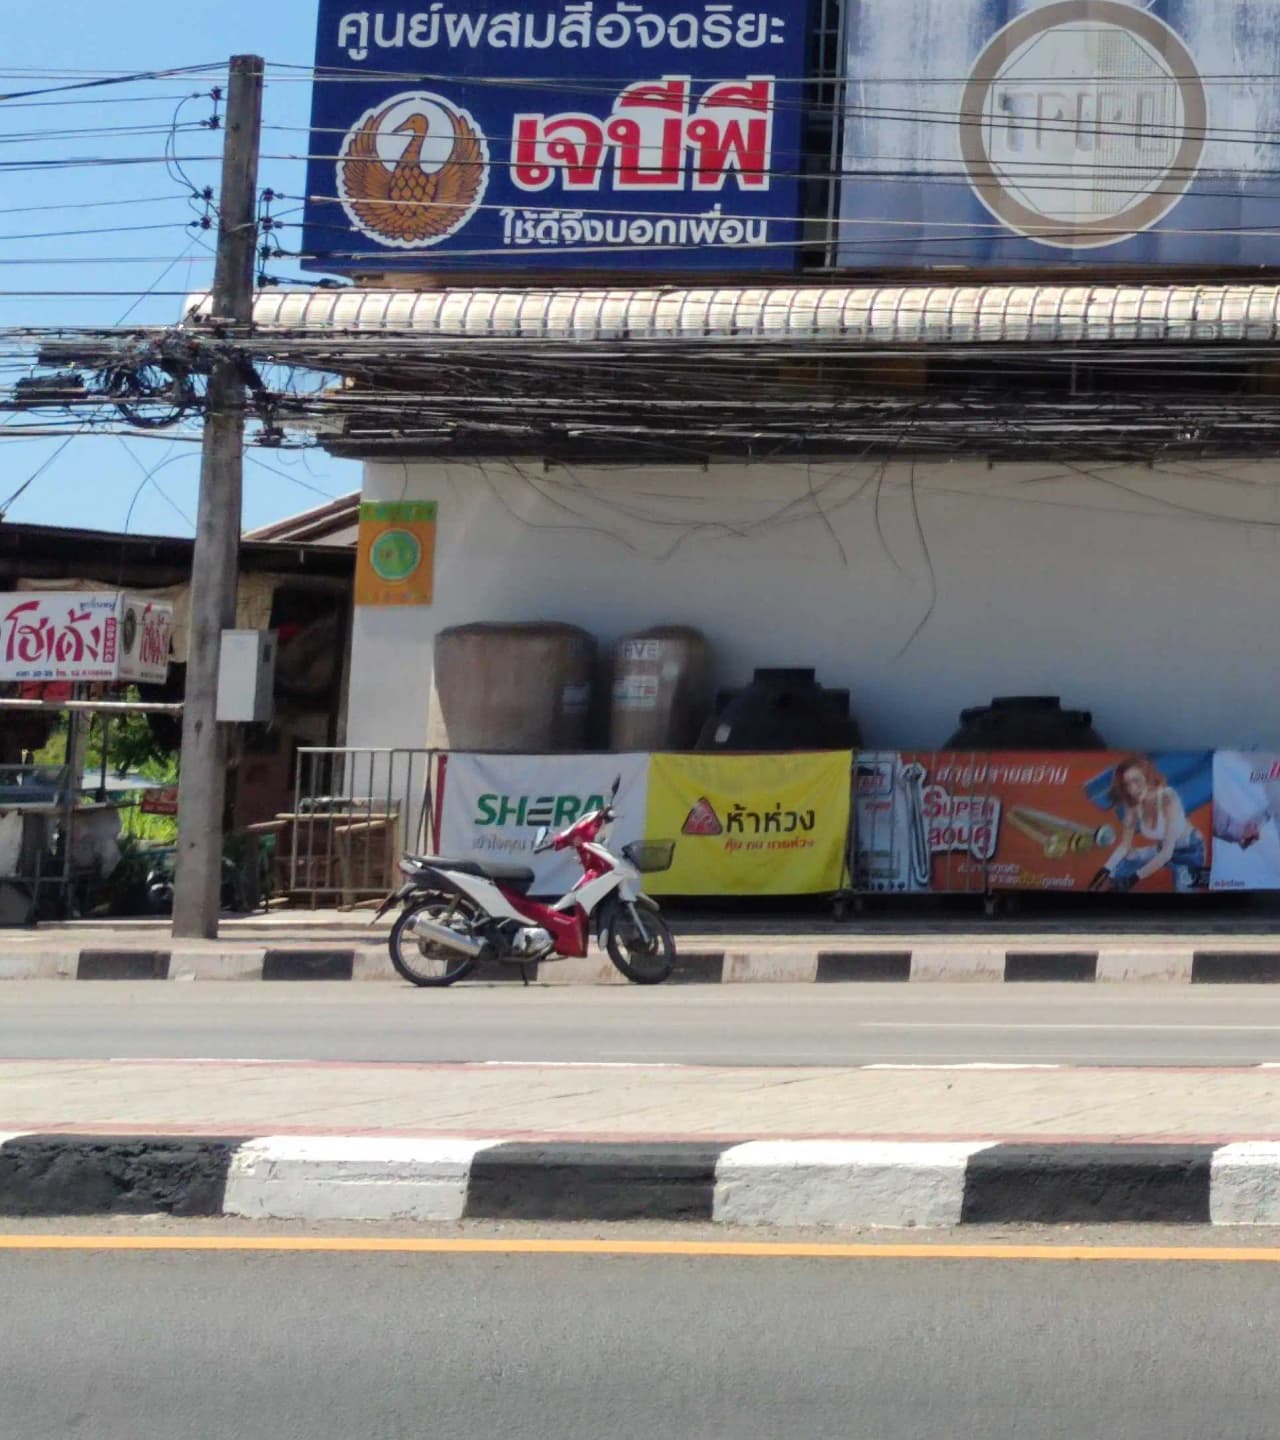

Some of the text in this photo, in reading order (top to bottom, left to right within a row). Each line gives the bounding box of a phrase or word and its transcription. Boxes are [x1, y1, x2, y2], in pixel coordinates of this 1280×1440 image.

[337, 2, 785, 60] ศูนย์ผสมสีอัจฉริยะ
[726, 802, 815, 833] ห้าห่วง
